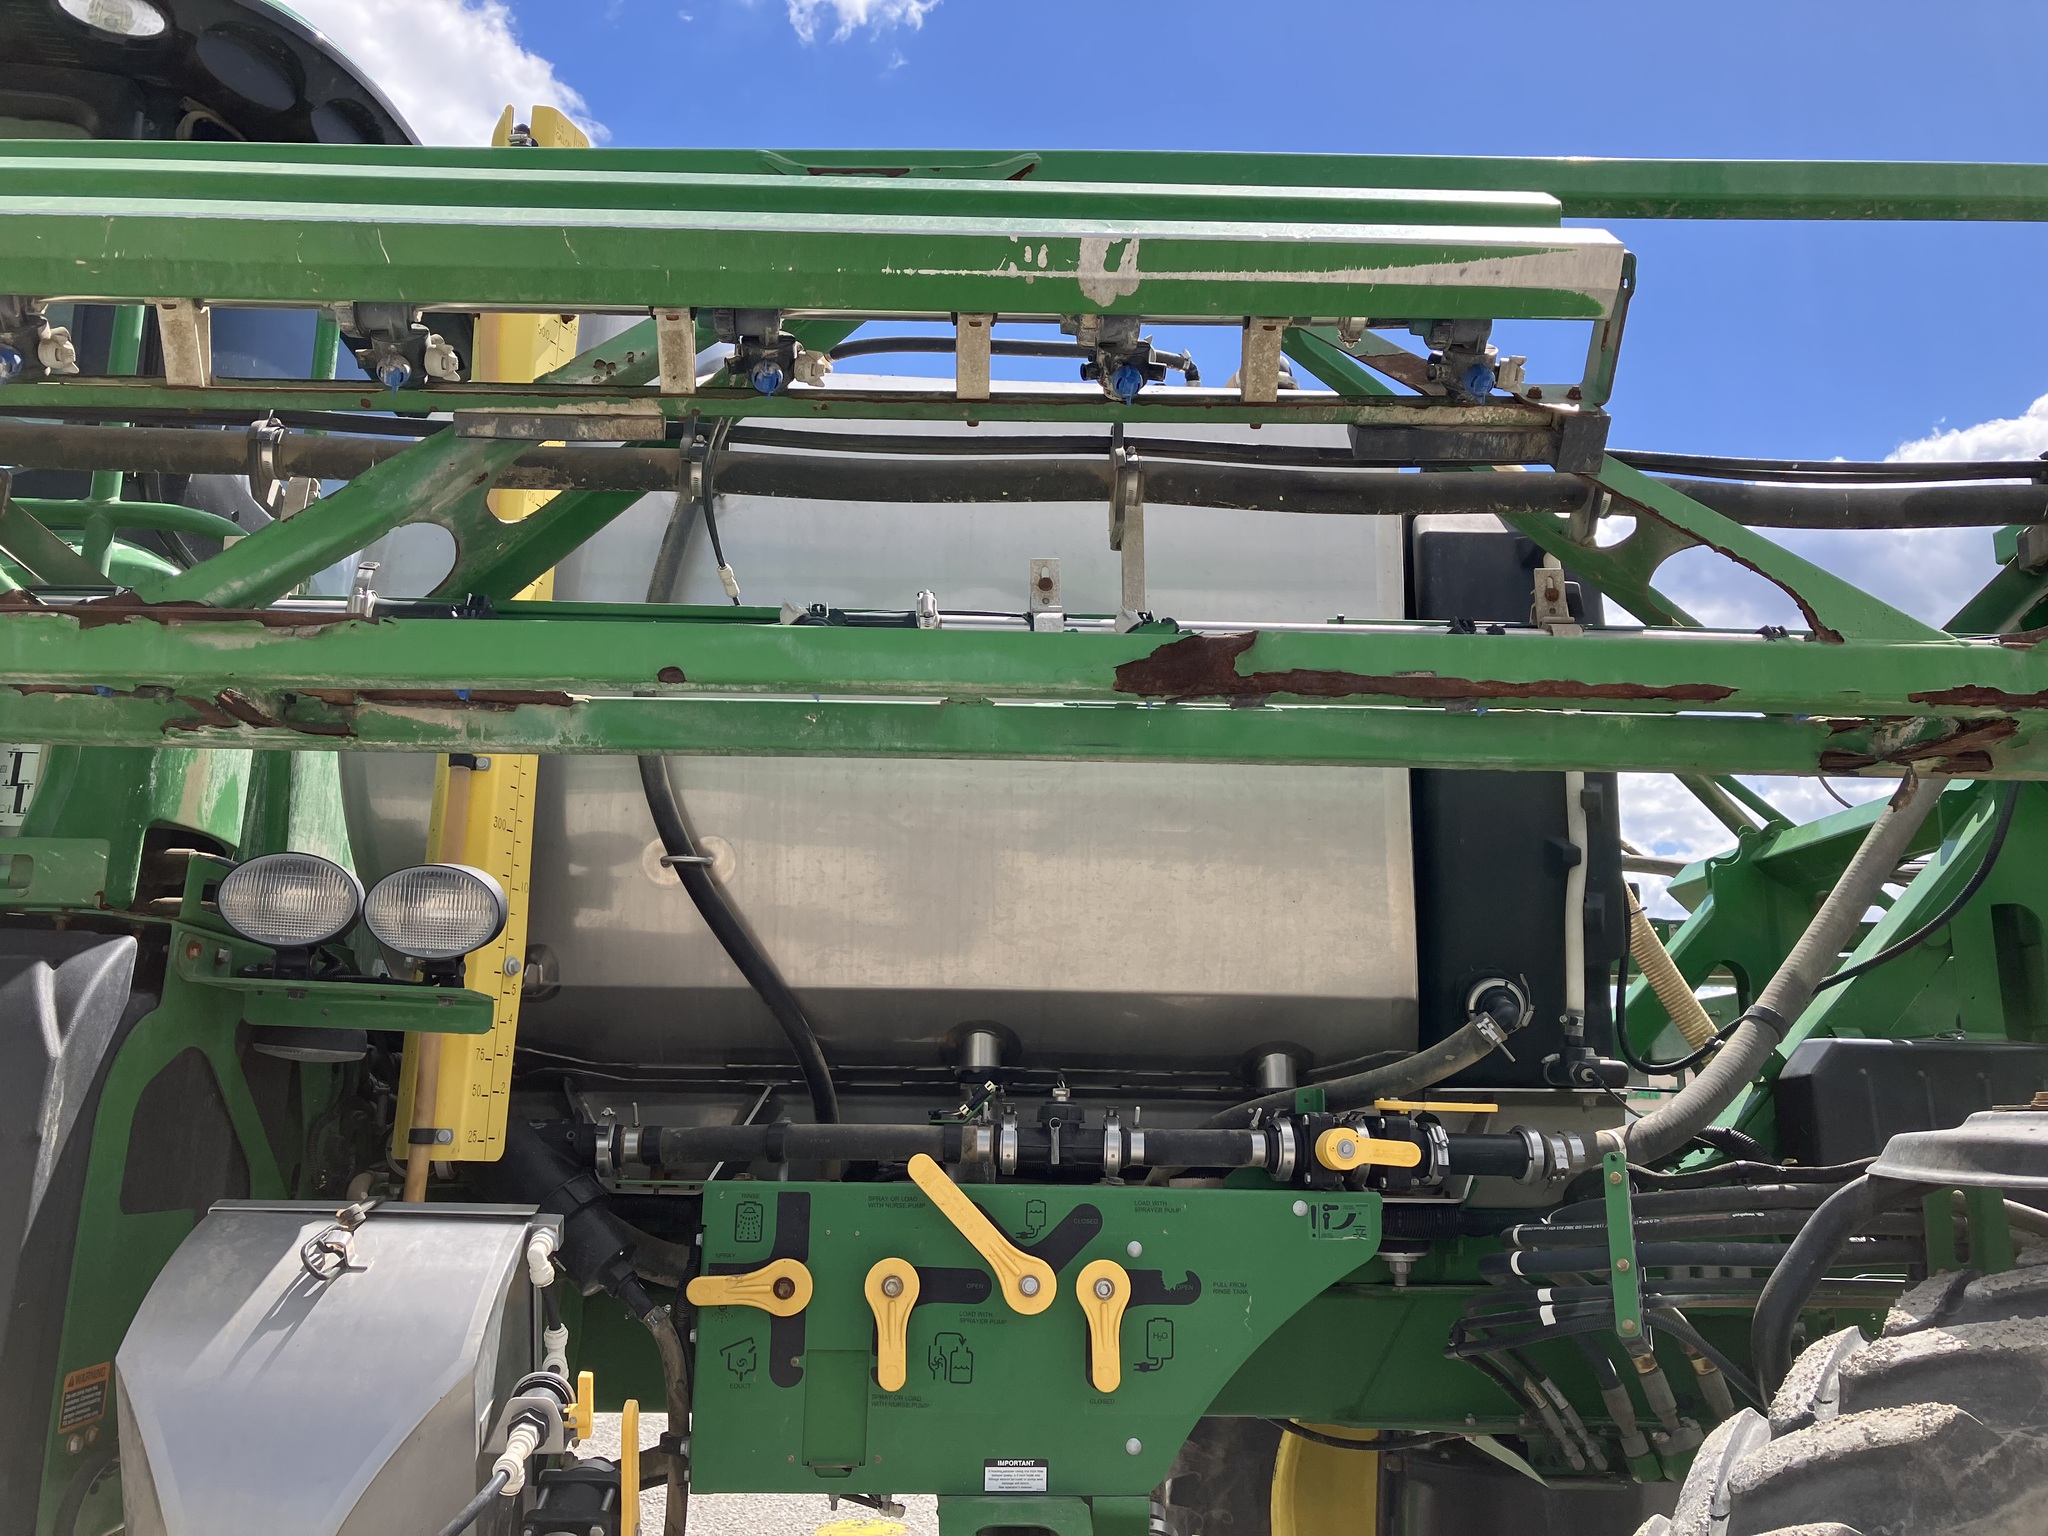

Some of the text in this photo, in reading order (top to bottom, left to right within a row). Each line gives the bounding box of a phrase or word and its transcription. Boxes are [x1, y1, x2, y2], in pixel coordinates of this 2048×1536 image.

[493, 816, 506, 830] 300
[521, 882, 529, 893] 10
[476, 1048, 484, 1060] 75
[472, 1084, 481, 1097] 50
[468, 1130, 477, 1143] 25
